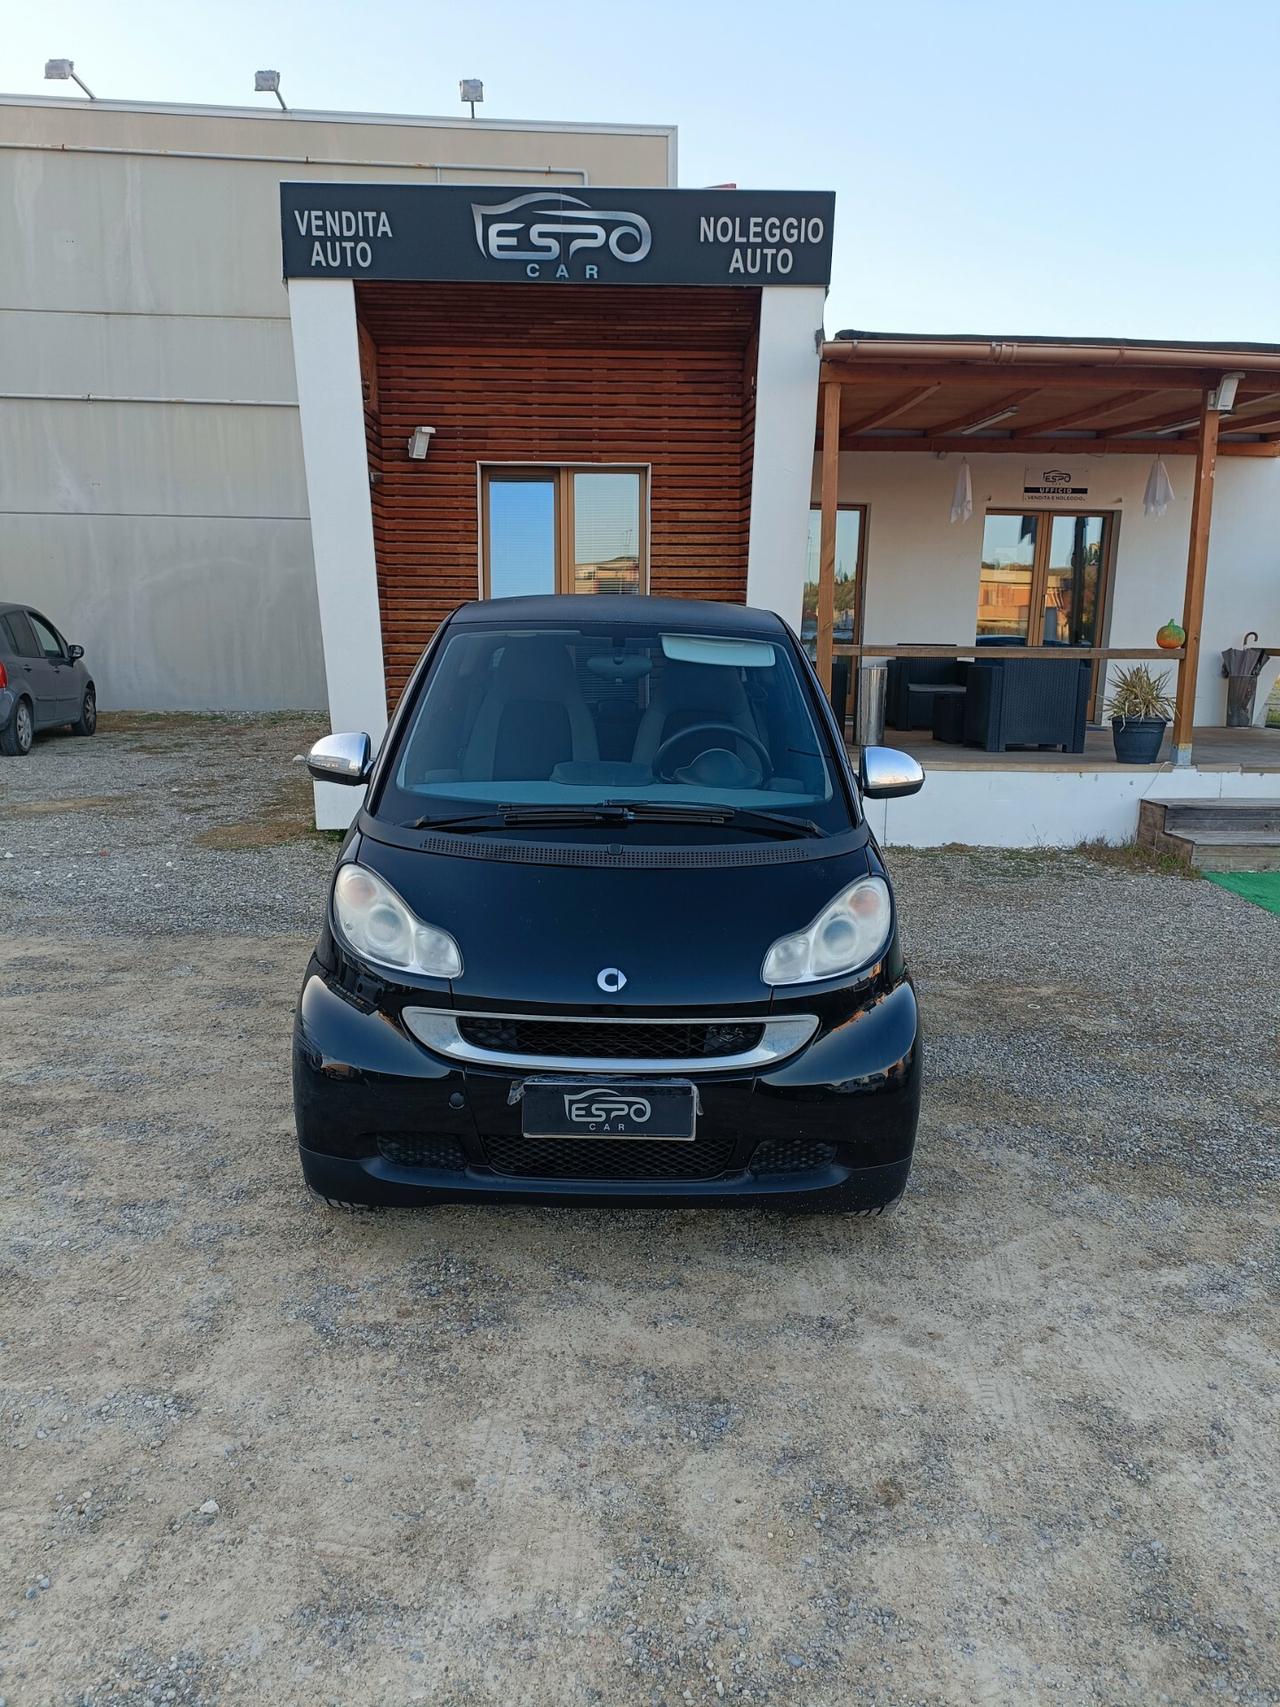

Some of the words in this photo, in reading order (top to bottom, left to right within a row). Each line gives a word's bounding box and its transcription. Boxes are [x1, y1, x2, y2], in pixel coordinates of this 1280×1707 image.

[294, 210, 393, 237] VENDITA
[488, 211, 652, 262] ESPO
[700, 216, 824, 244] NOLEGGIO
[311, 241, 372, 267] AUTO
[728, 248, 793, 273] AUTO
[526, 263, 598, 279] CAR
[1044, 472, 1071, 483] ESPO
[571, 1096, 651, 1123] ESPO
[588, 1123, 625, 1131] CAR
